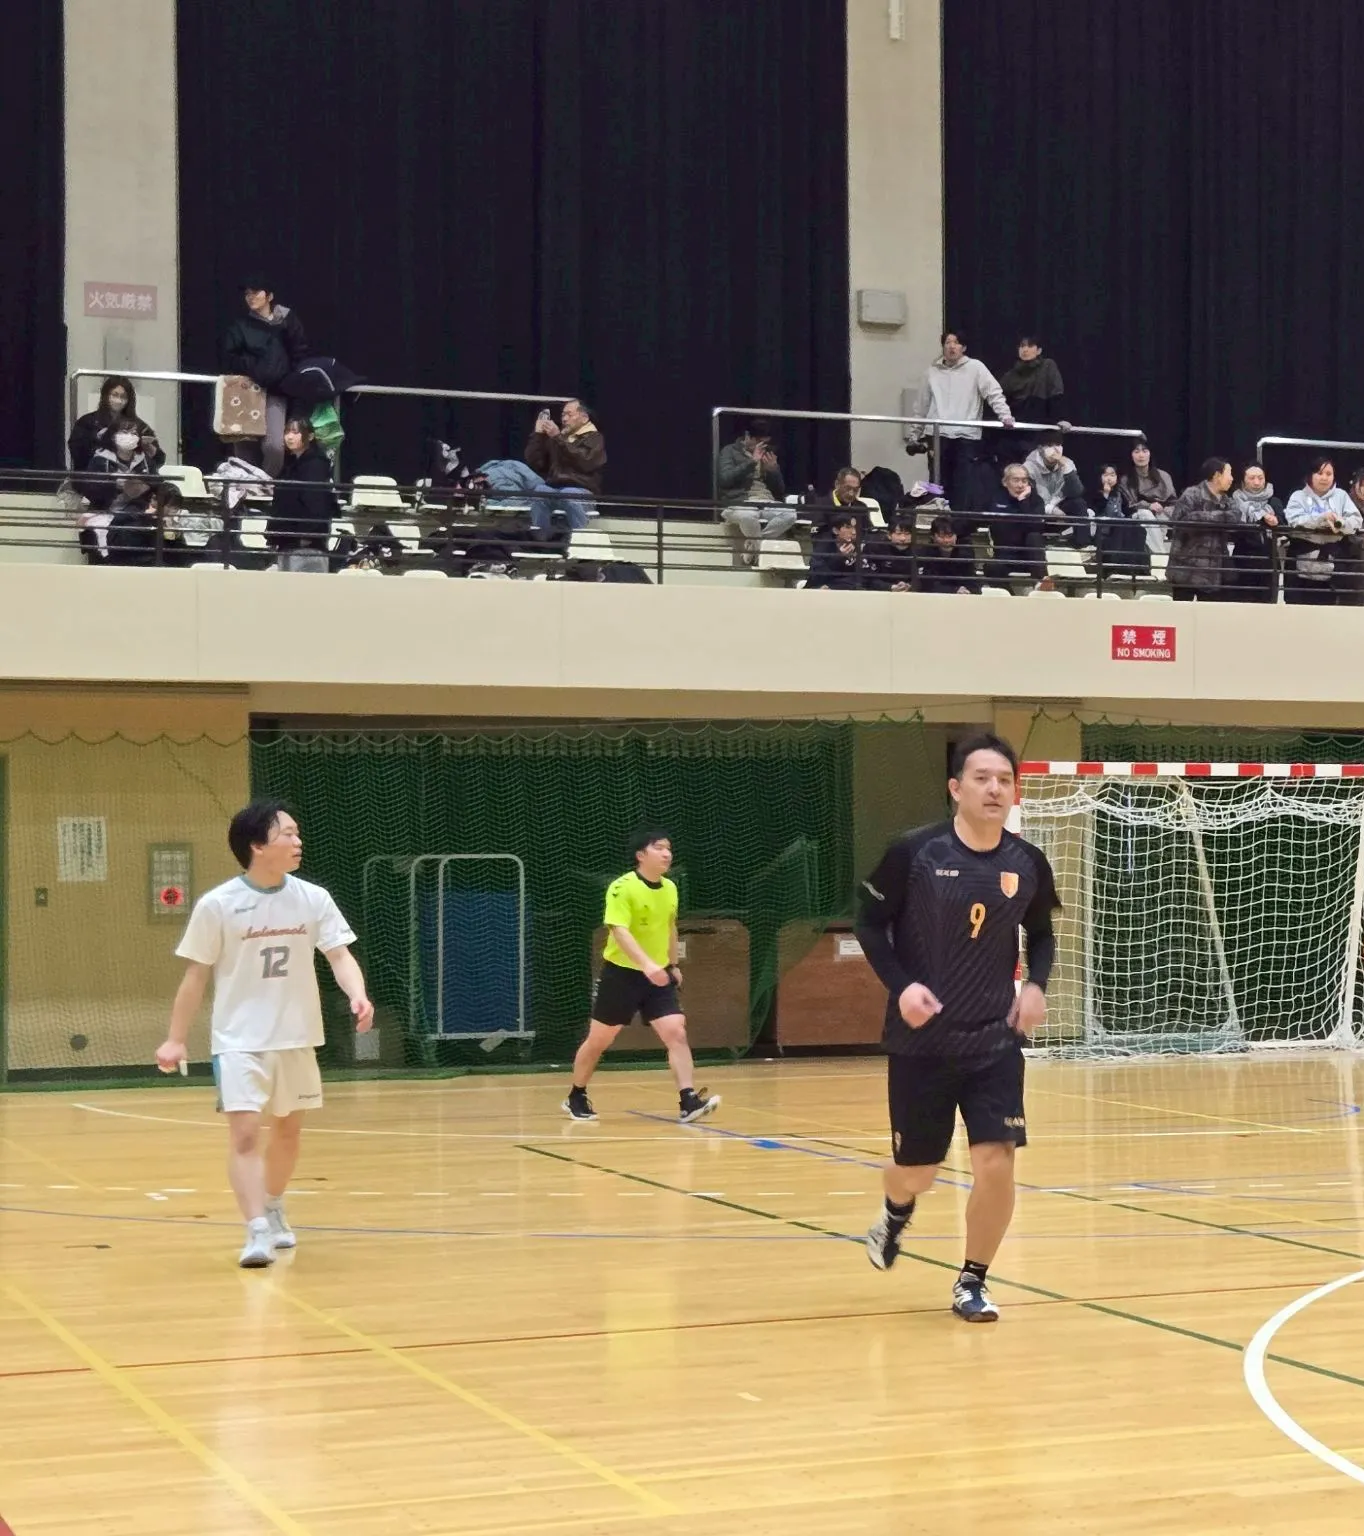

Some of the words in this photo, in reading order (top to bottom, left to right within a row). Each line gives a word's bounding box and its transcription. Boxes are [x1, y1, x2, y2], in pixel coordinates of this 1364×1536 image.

[88, 290, 153, 311] 火気厳禁
[1117, 648, 1130, 657] NO
[1132, 648, 1171, 659] SMOKING
[970, 902, 986, 939] 9
[260, 945, 290, 979] 12
